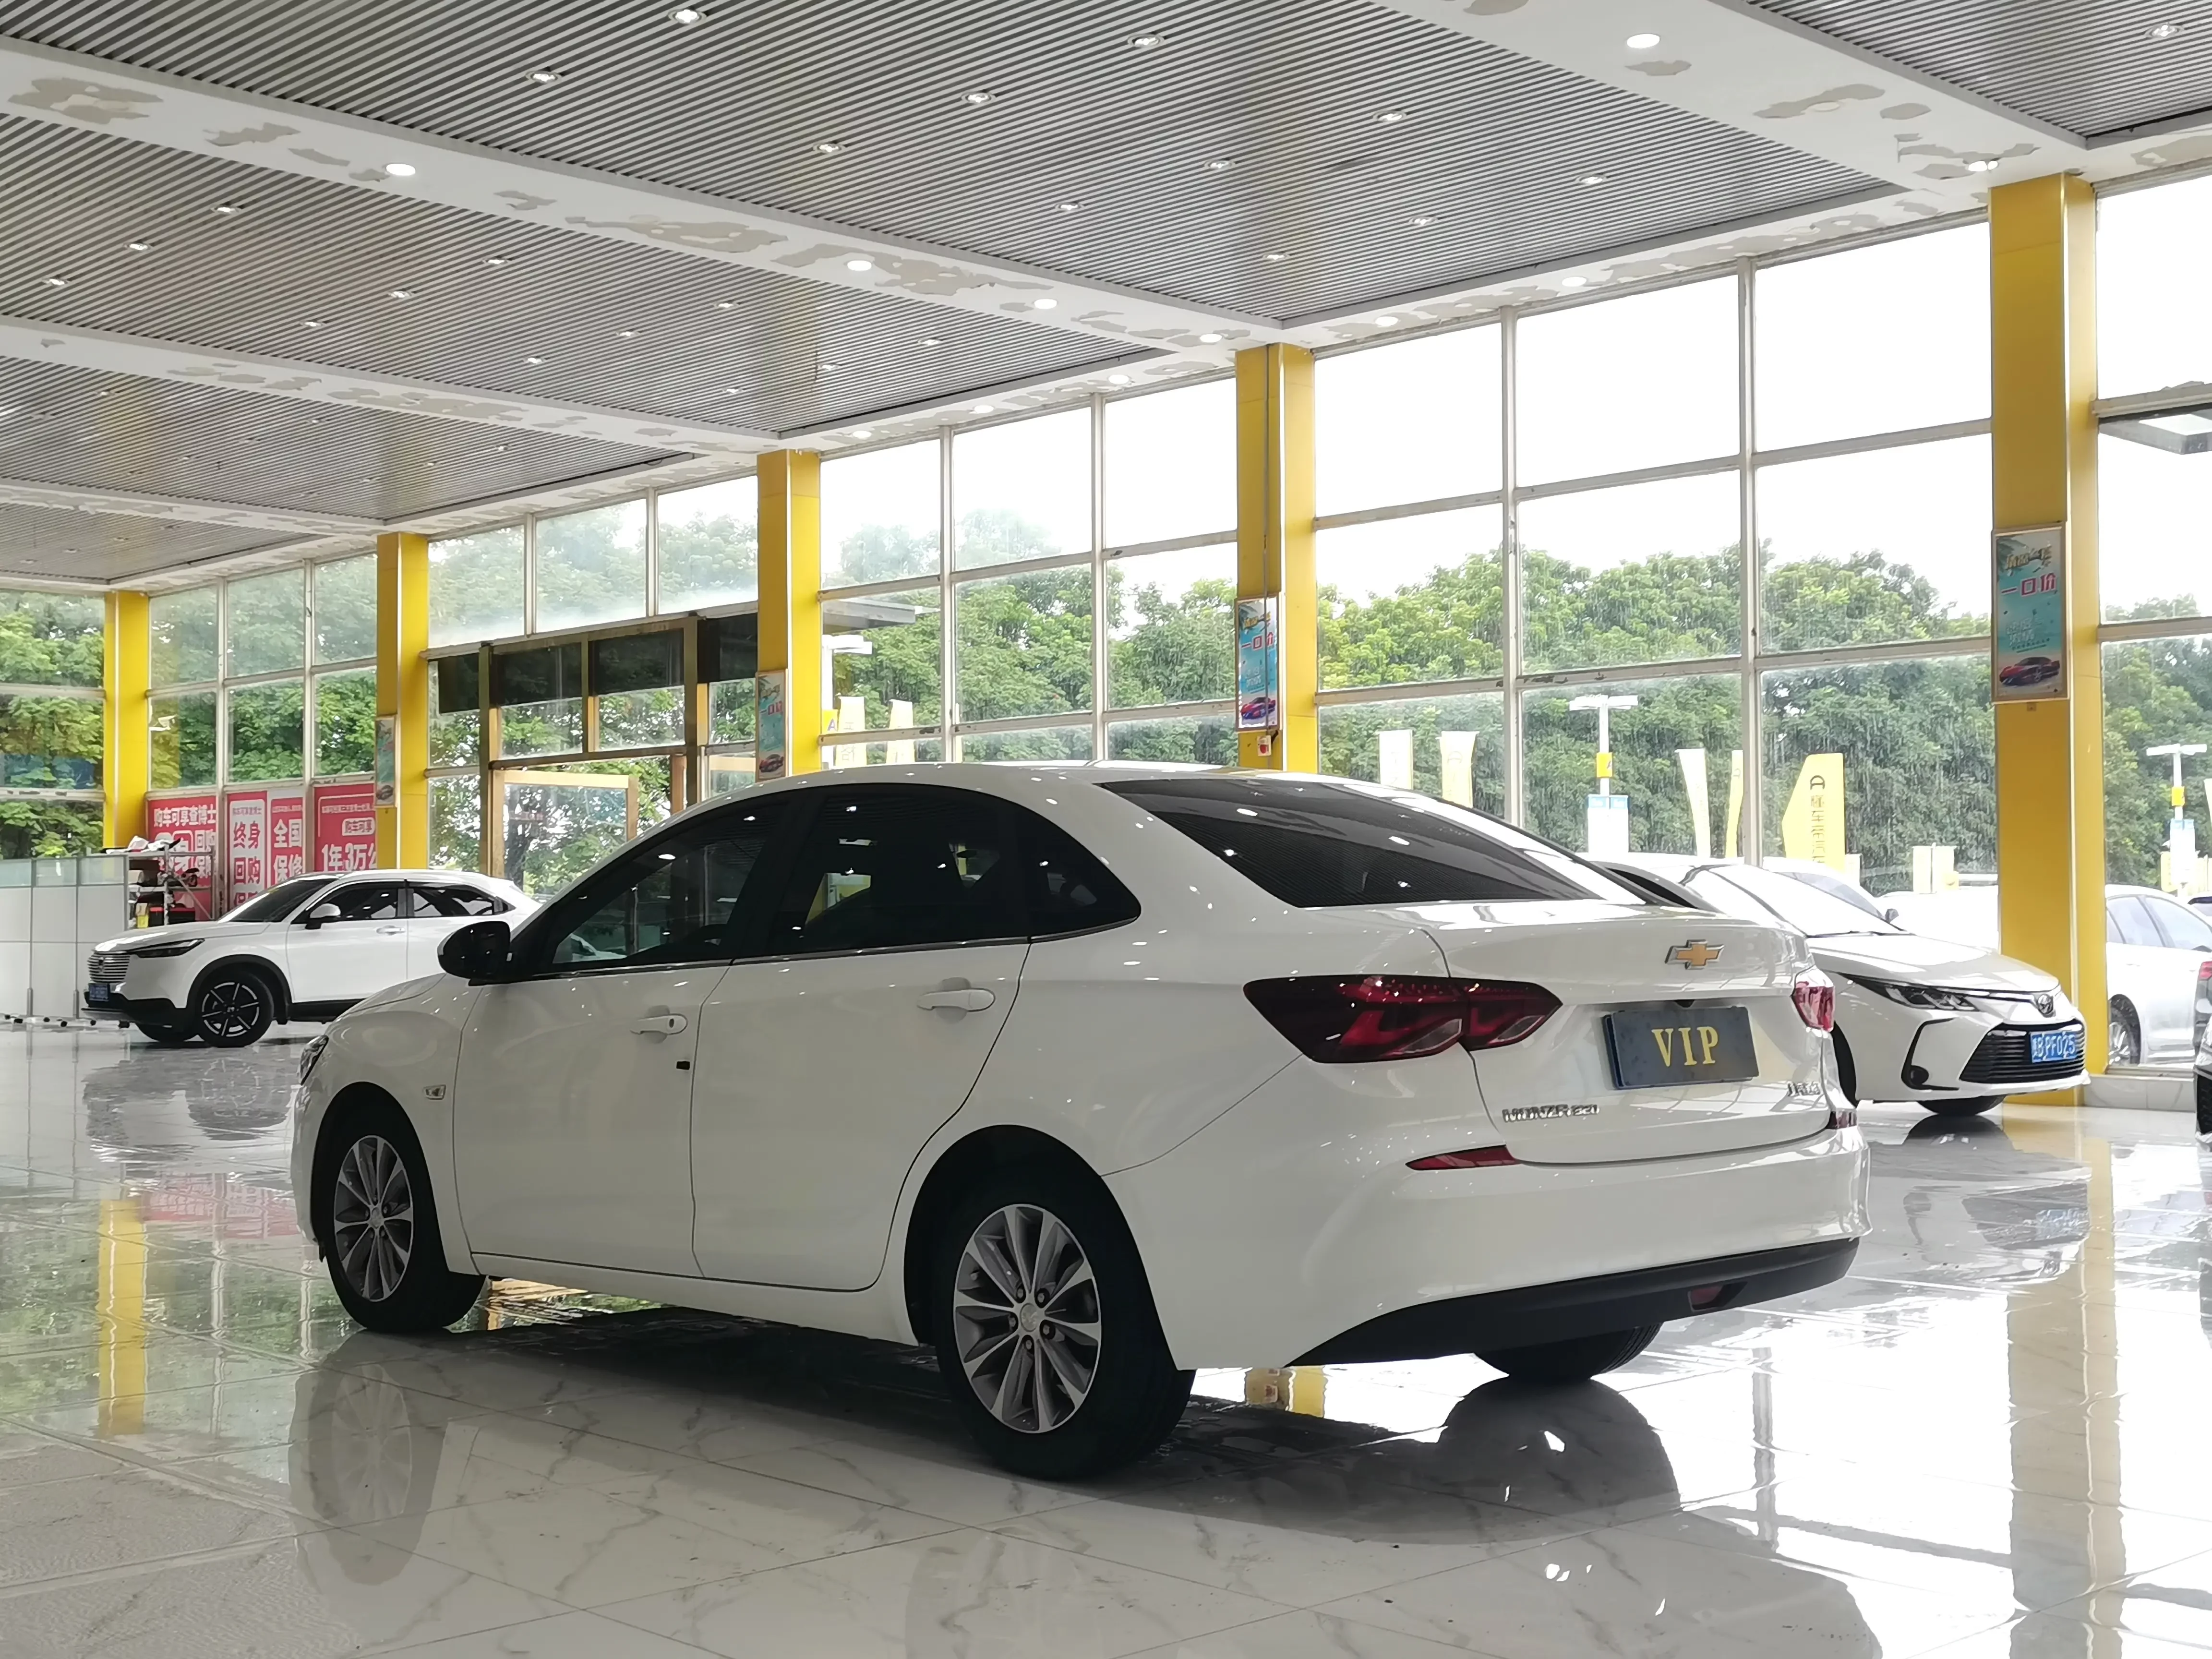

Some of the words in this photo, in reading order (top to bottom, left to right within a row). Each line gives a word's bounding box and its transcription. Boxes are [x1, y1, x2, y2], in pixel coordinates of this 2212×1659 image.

[2001, 573, 2056, 596] 一口价
[154, 804, 216, 827] 购车可享查博士
[233, 821, 261, 849] 终身
[274, 819, 302, 847] 全国
[234, 856, 261, 885] 回购
[1651, 1026, 1718, 1067] VIP
